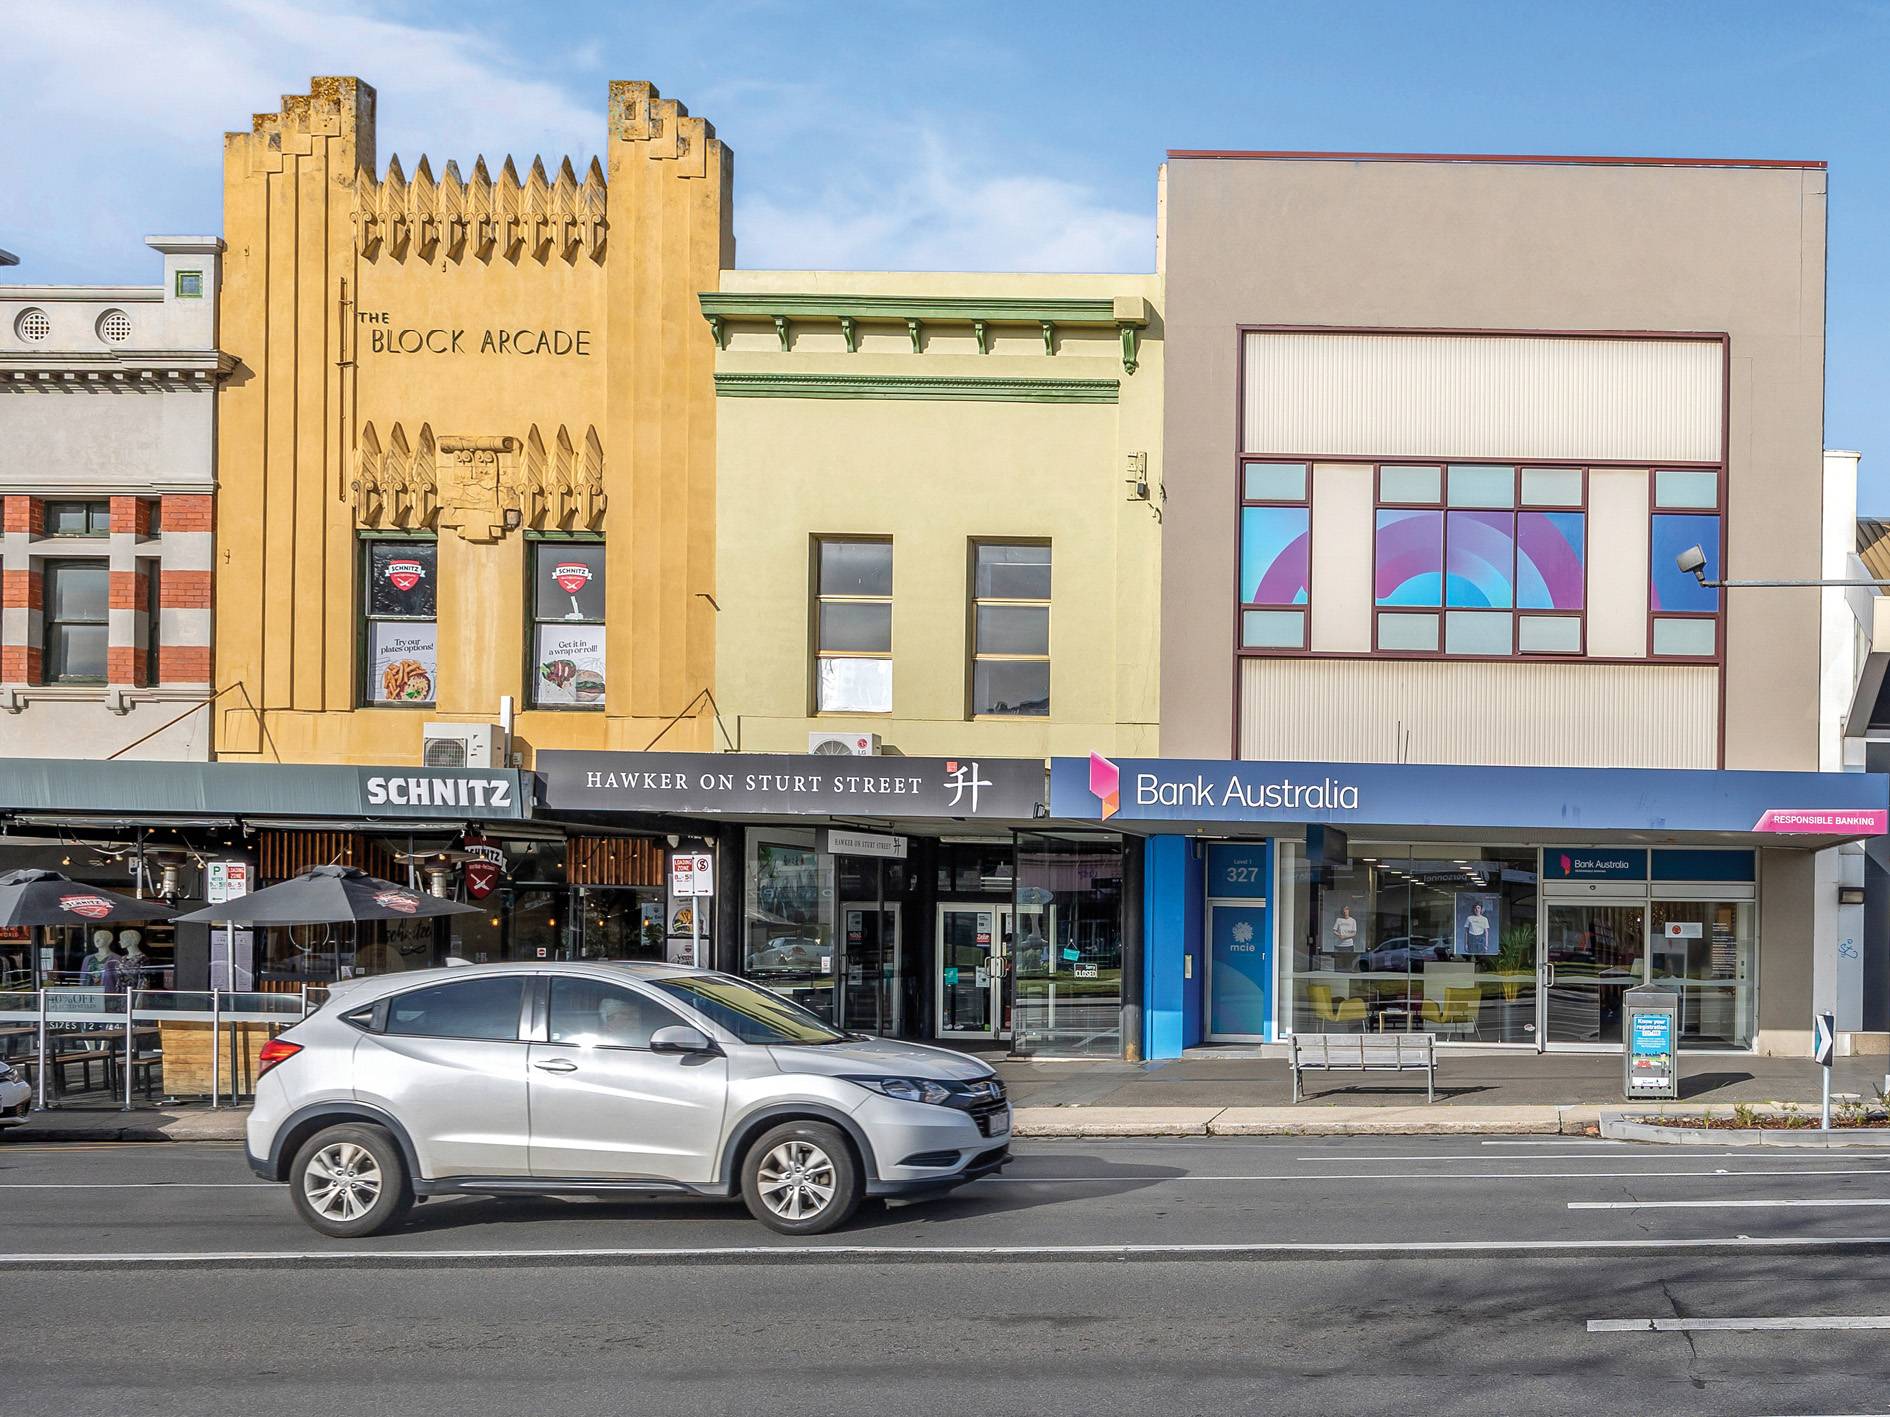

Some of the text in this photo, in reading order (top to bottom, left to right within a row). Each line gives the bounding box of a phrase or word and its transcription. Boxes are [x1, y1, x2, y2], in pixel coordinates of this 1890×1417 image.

[358, 312, 389, 324] THE
[371, 329, 591, 355] BLOCK ARCADE
[380, 643, 434, 655] plates options!
[393, 639, 407, 650] Try
[558, 640, 572, 648] Get
[572, 640, 579, 648] it
[586, 771, 923, 794] HAWKER ON STURT STREET
[943, 762, 993, 813] 升
[367, 777, 512, 807] SCHNITZ
[1137, 773, 1359, 809] Bank Australia
[1774, 816, 1875, 826] RESPONSIBLE BANKING
[213, 865, 221, 876] P
[1574, 860, 1629, 869] Bank Australia
[1226, 867, 1259, 882] 327
[1230, 943, 1256, 952] mcie
